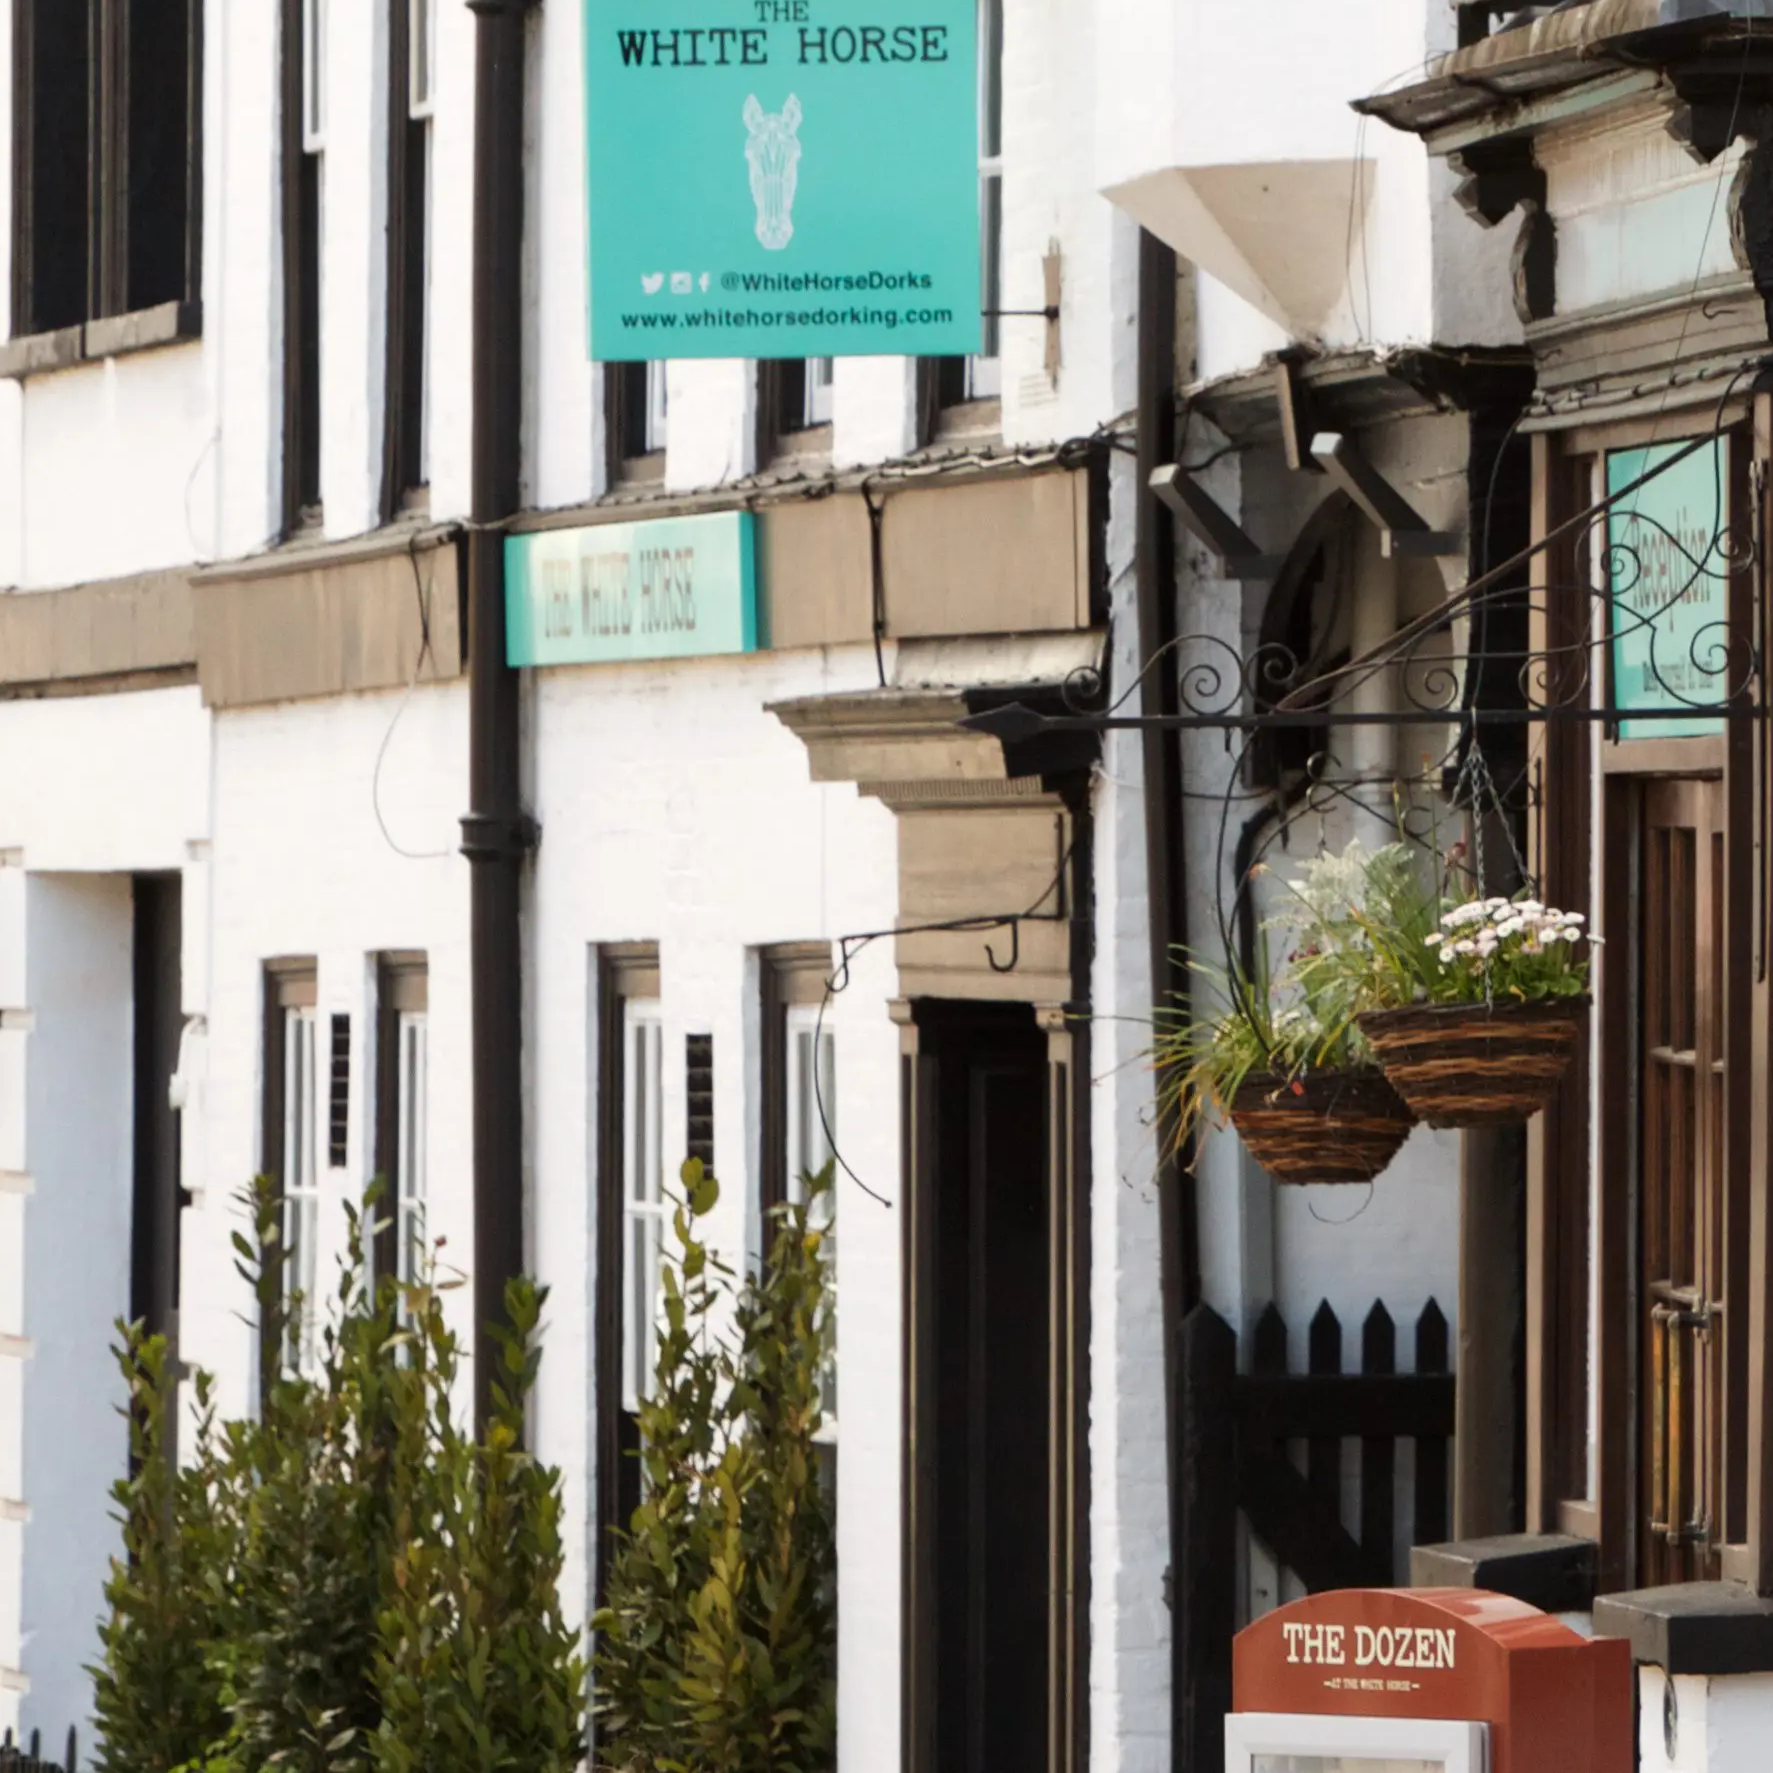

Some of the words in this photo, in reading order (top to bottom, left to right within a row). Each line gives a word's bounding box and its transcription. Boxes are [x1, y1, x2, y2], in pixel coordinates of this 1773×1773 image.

[754, 0, 809, 23] THE
[617, 27, 769, 67] WHITE
[797, 25, 949, 64] HORSE
[721, 270, 932, 292] @WhiteHorseDorks
[621, 305, 953, 329] www.whitehorsedorking.com
[639, 546, 696, 634] HORSE
[1630, 505, 1711, 634] Reception
[1283, 1622, 1345, 1666] THE
[1355, 1625, 1456, 1669] DOZEN
